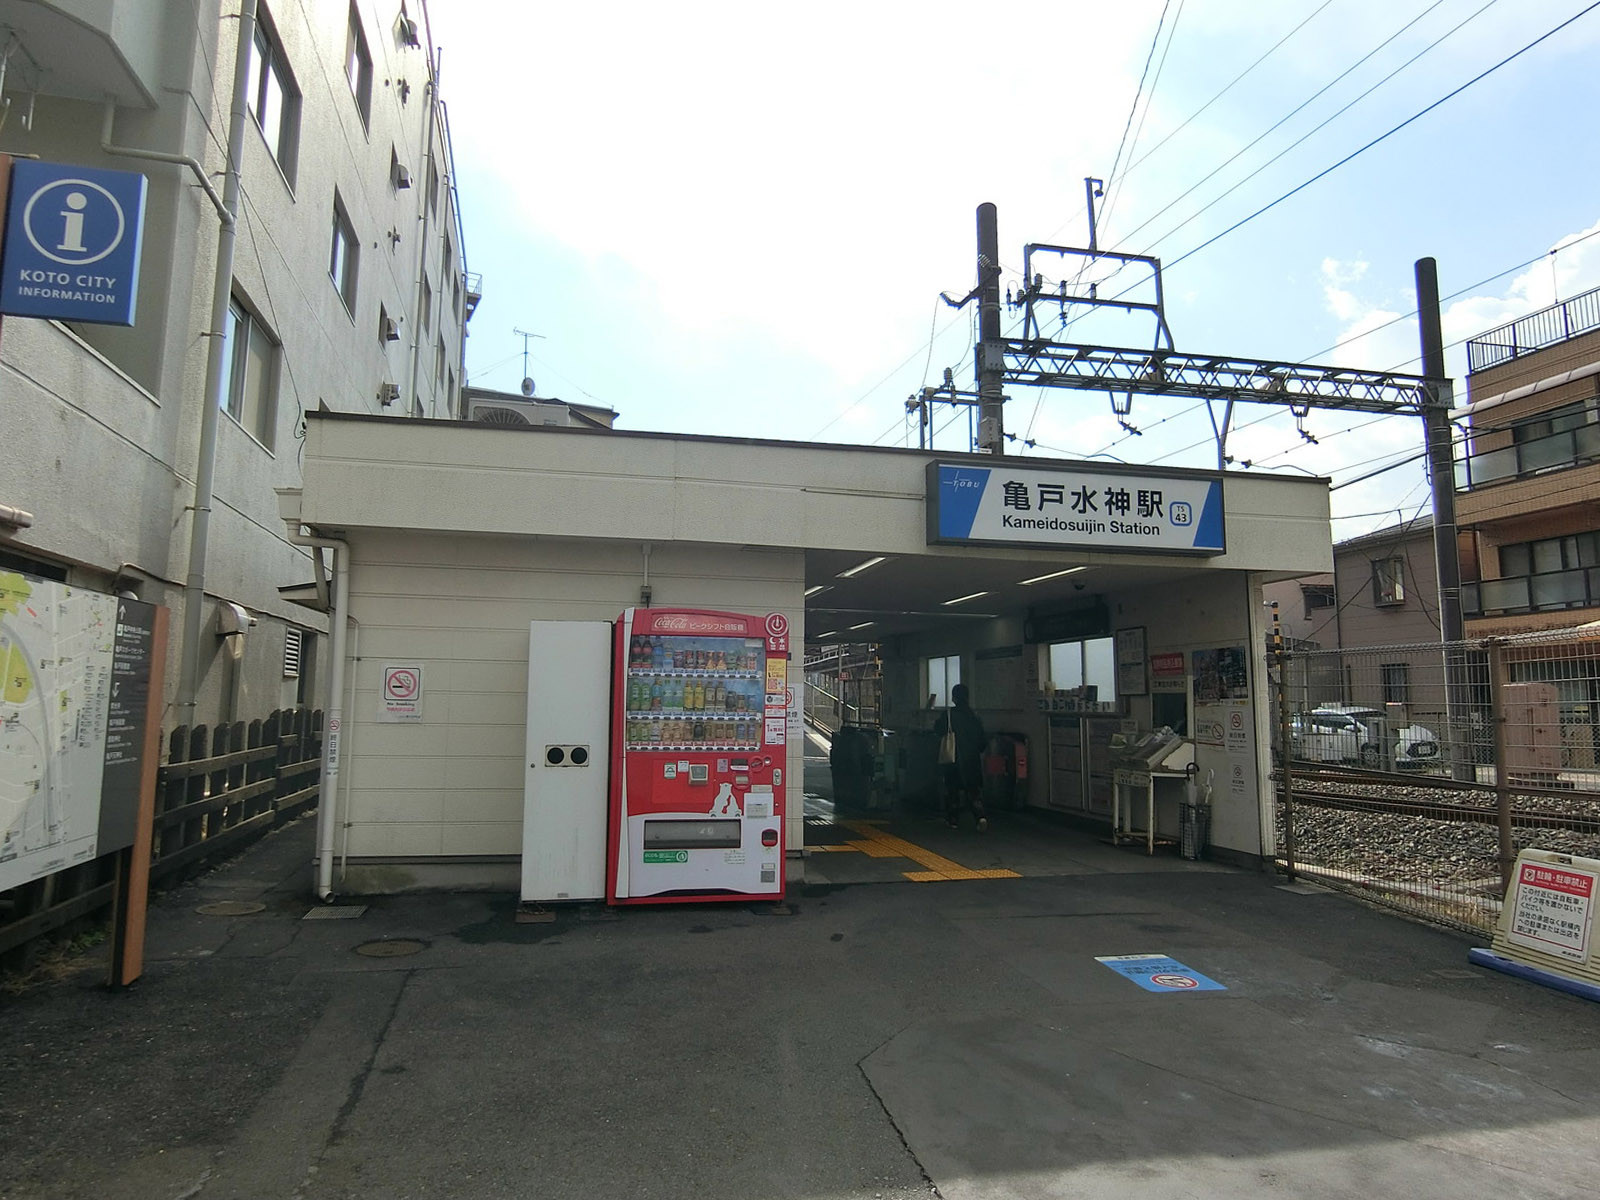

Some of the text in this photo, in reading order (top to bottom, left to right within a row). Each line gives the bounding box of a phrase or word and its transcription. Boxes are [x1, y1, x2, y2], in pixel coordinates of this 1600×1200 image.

[20, 269, 117, 289] KOTO CITY
[18, 286, 116, 304] INFORMATION
[1002, 480, 1164, 519] 亀戸水神駅
[1002, 515, 1160, 536] Kameidosuijin Station
[1175, 513, 1187, 523] 43
